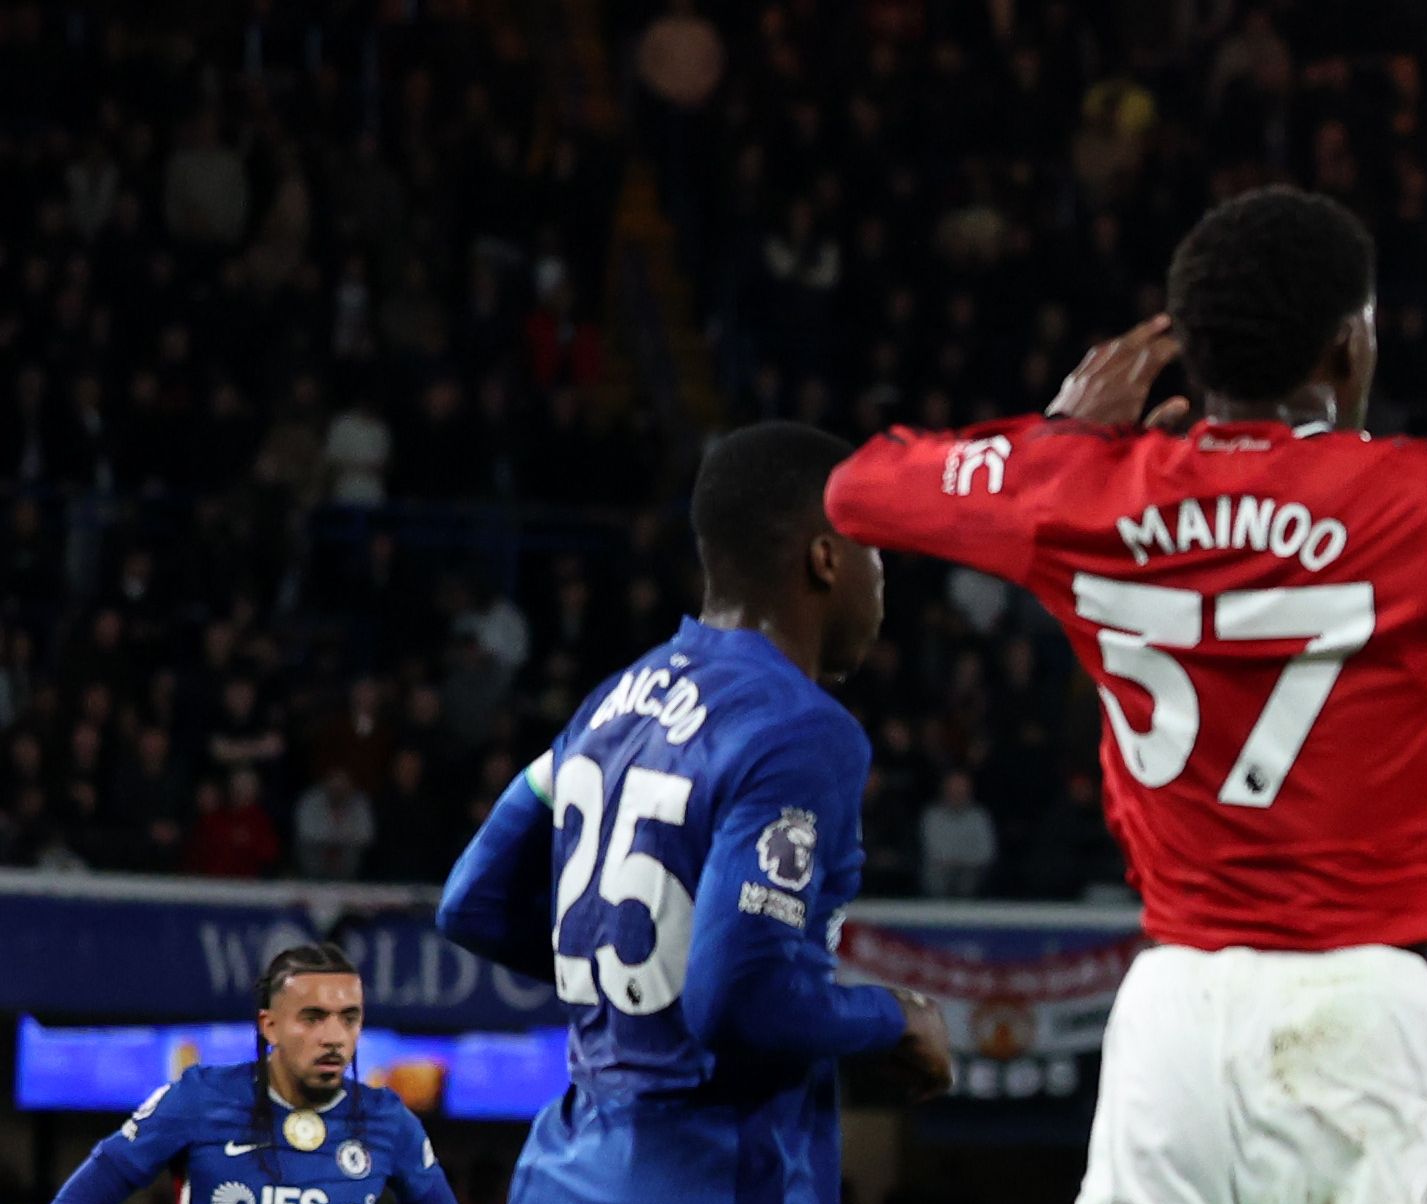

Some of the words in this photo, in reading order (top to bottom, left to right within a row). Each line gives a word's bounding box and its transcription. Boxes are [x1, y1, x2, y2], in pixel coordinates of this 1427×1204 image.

[1117, 496, 1348, 571] MAINOO
[1073, 573, 1374, 808] 37
[200, 919, 481, 1008] WLD
[552, 754, 698, 1016] 25
